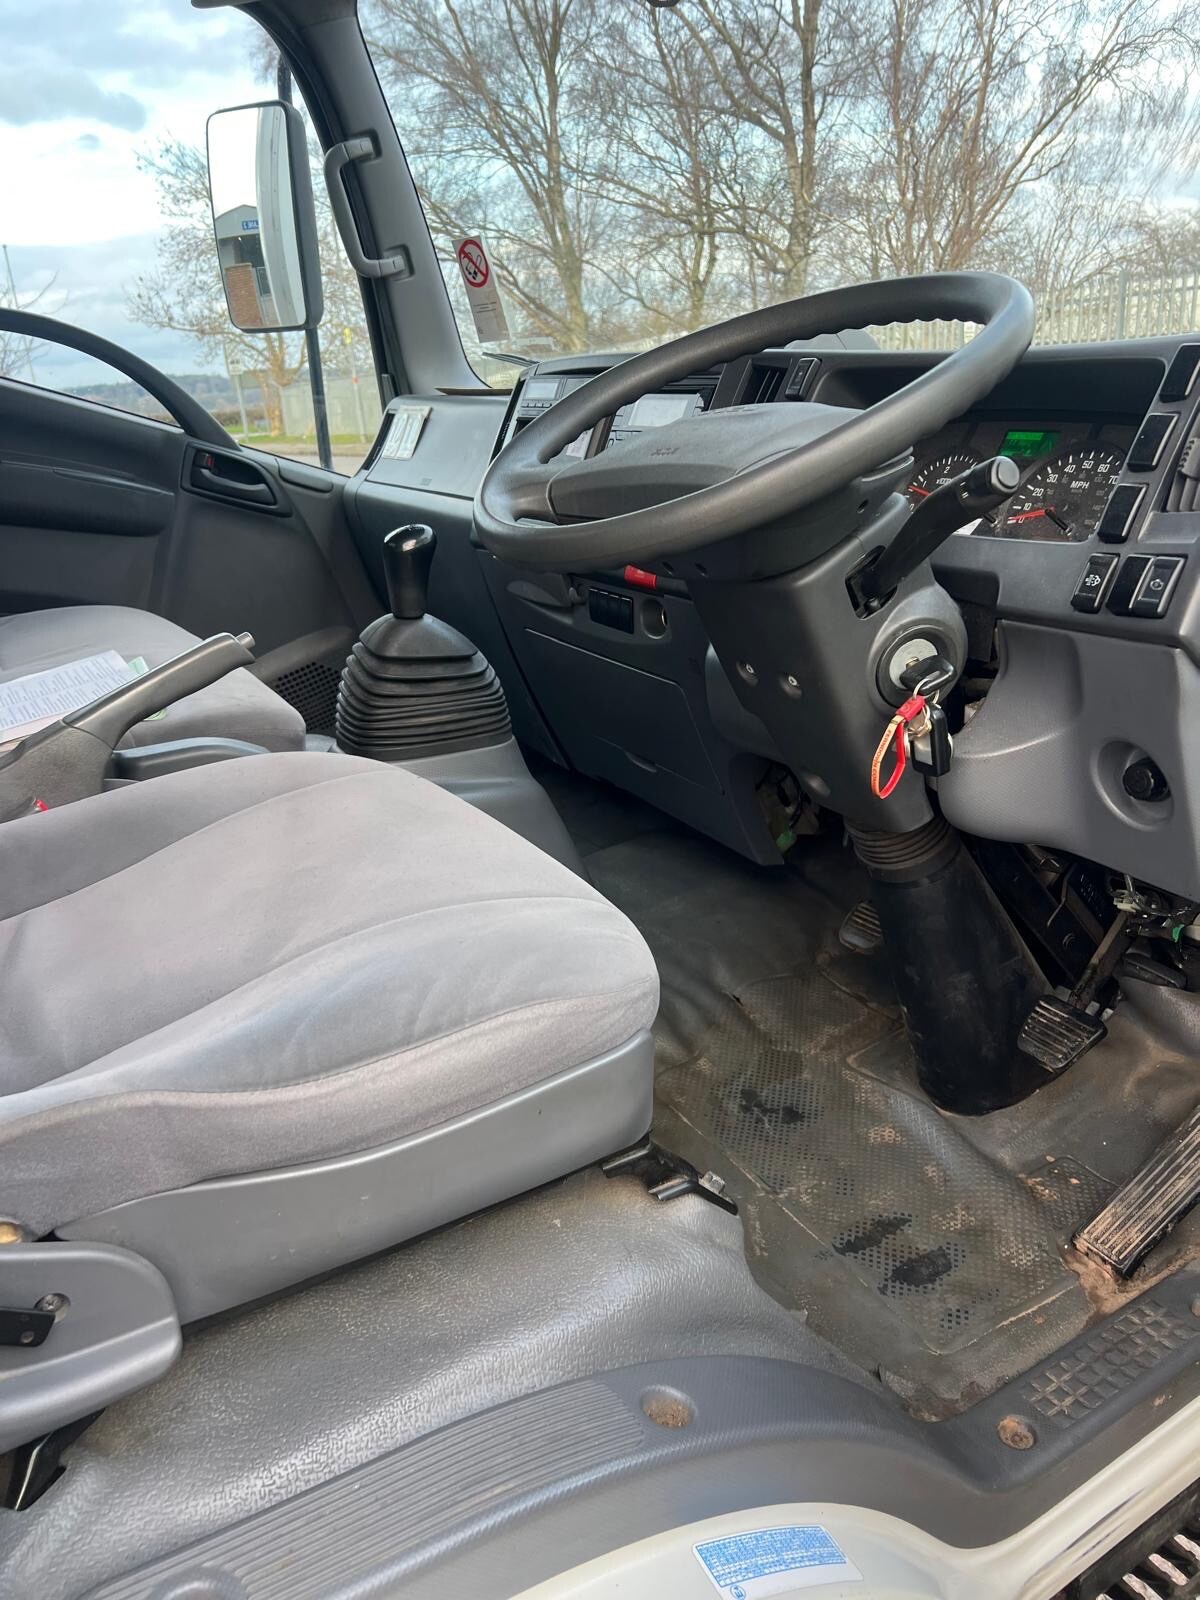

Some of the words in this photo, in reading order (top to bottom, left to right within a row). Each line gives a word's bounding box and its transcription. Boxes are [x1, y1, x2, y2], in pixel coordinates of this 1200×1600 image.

[1064, 464, 1076, 473] 40
[1081, 460, 1094, 469] 50
[1097, 464, 1110, 473] 60
[943, 466, 950, 474] 2
[1046, 474, 1058, 483] 30
[1108, 475, 1120, 485] 70
[1070, 480, 1090, 489] MPH
[1032, 488, 1044, 497] 20
[1023, 502, 1032, 511] 10
